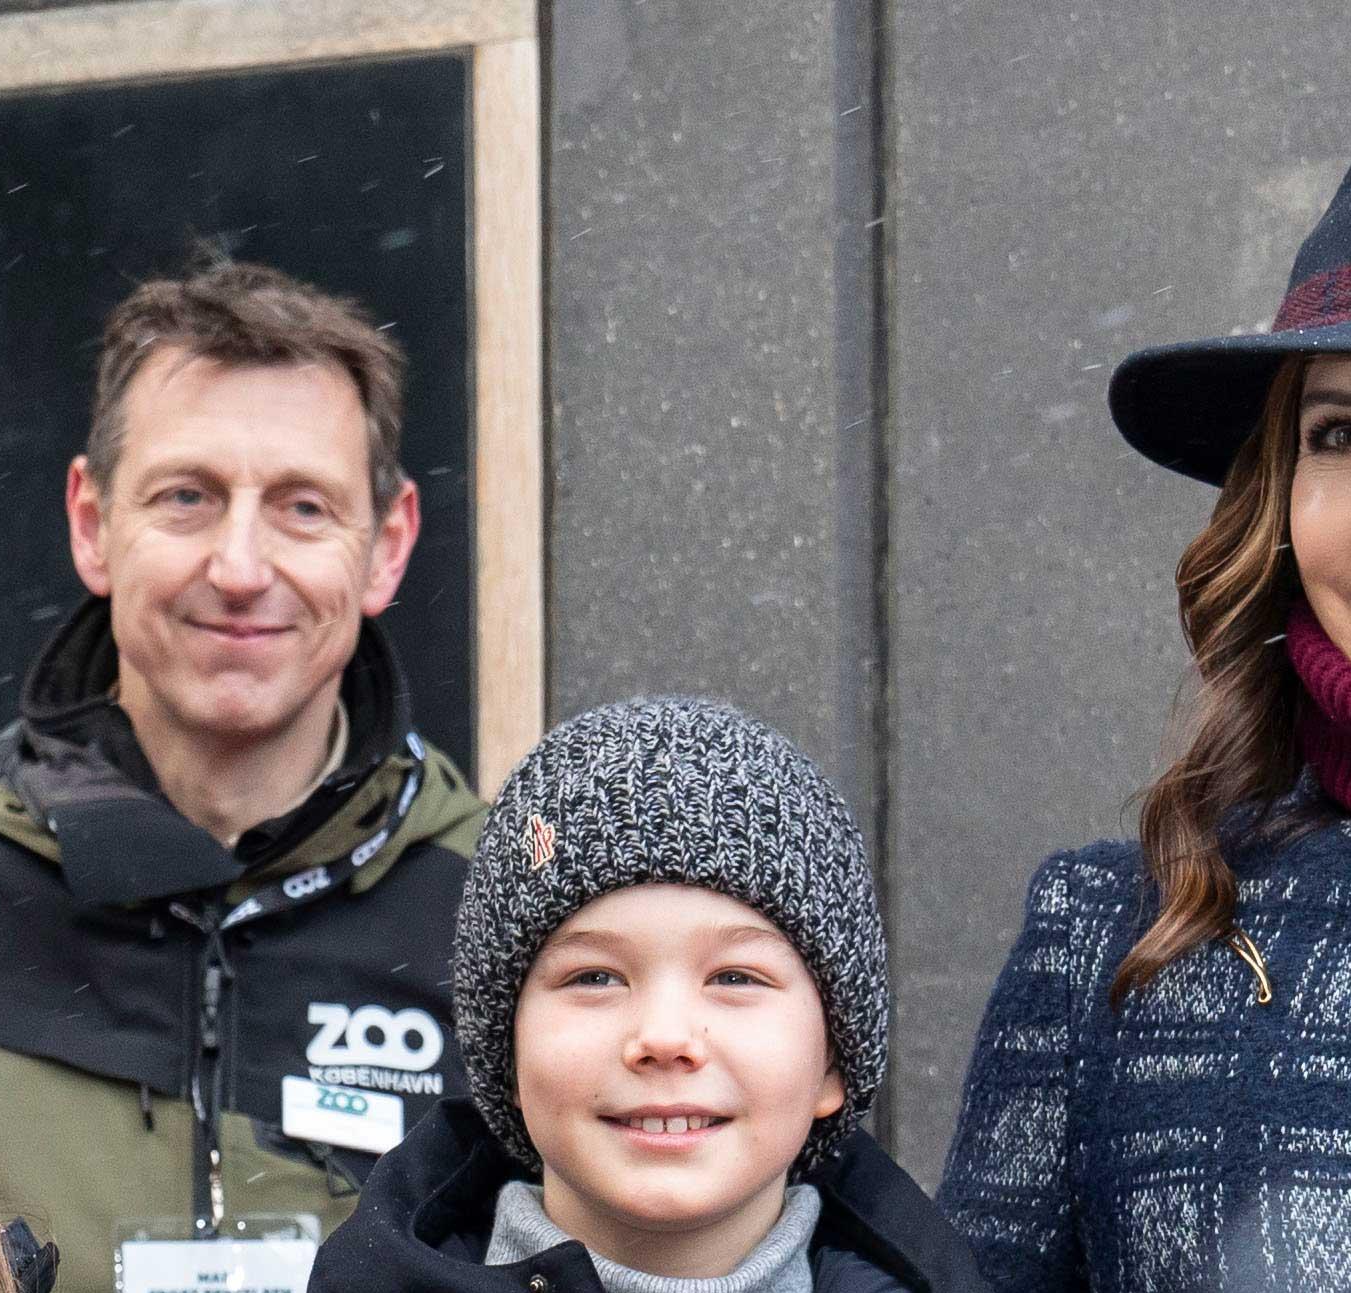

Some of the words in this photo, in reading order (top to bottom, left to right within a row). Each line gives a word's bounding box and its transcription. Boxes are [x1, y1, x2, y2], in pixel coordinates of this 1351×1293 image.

[306, 1002, 444, 1071] ZOO
[308, 1066, 444, 1095] KØBENHAVN
[316, 1087, 368, 1116] ZOO
